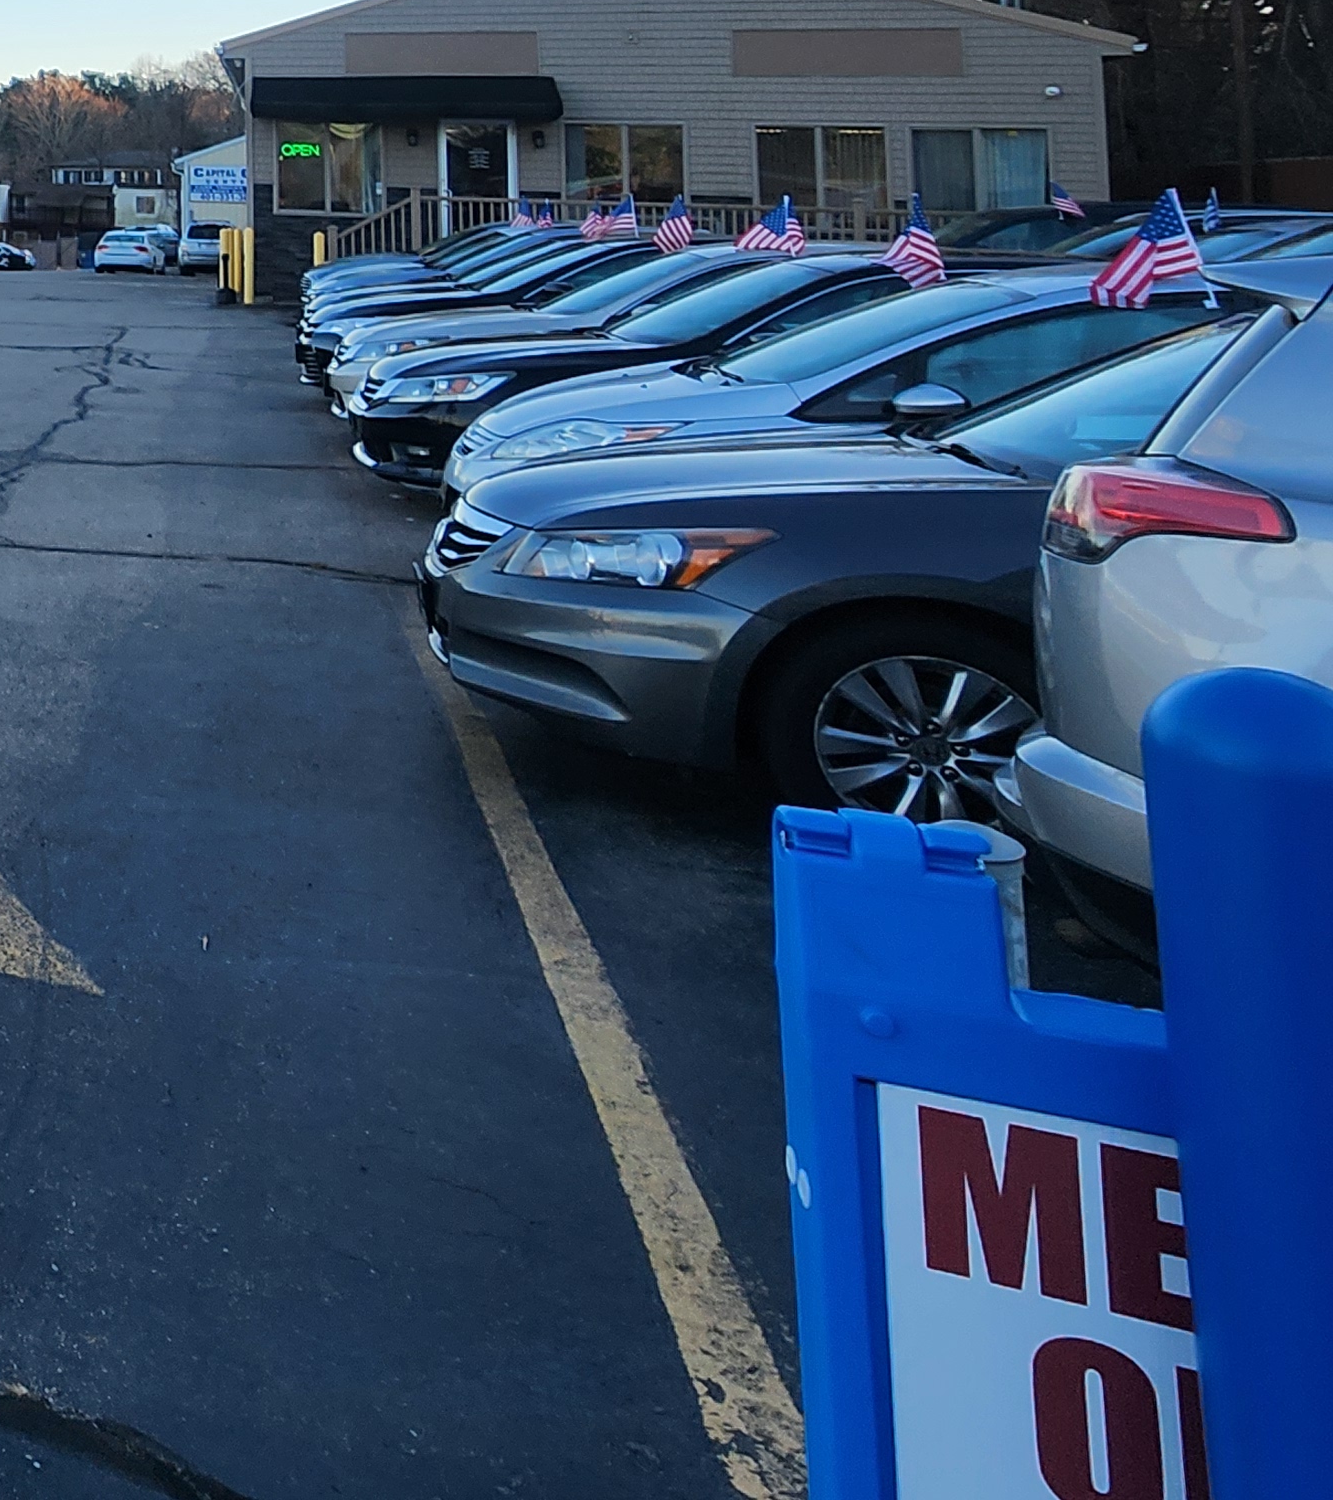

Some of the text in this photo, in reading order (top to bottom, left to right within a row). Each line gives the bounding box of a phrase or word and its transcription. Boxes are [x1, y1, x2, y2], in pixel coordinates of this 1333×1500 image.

[281, 143, 320, 157] OPEN
[194, 167, 236, 177] CAPITAL
[1032, 1336, 1213, 1500] O
